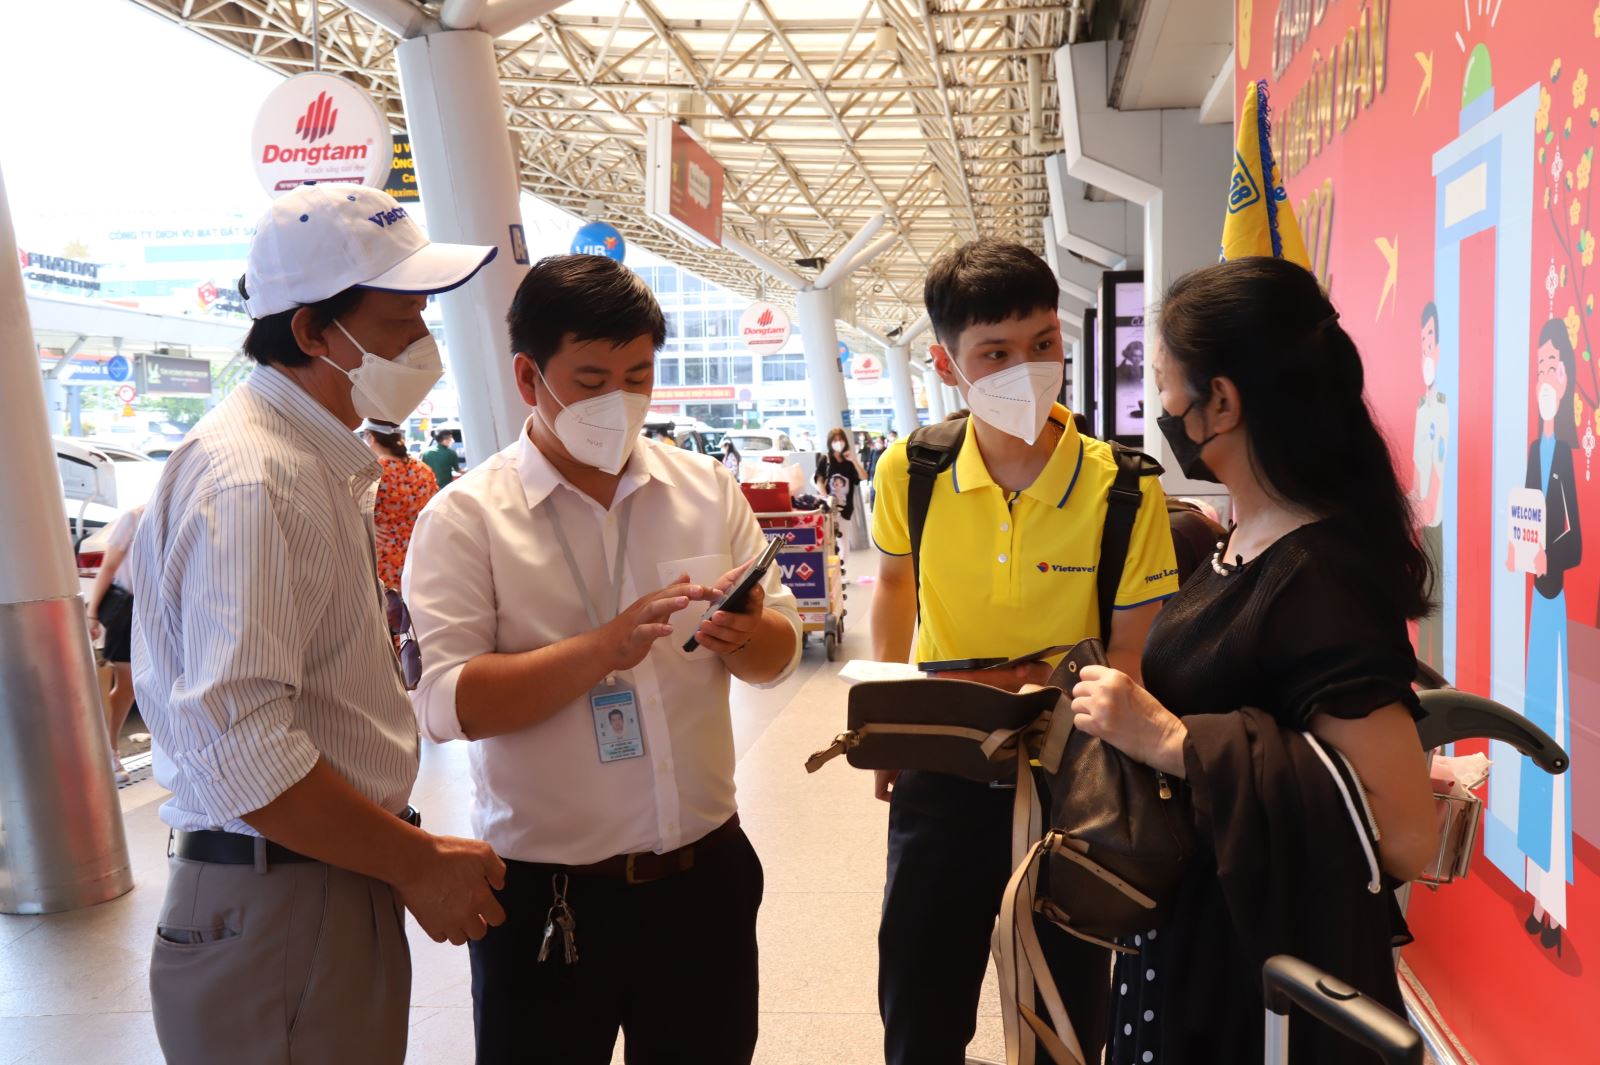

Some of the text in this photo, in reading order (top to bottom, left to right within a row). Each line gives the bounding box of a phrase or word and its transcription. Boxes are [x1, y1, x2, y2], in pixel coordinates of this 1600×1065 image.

[262, 143, 367, 166] Dongtam
[744, 327, 785, 335] Dongtam
[1511, 505, 1542, 522] WELCOME
[1513, 526, 1539, 543] TO 2022
